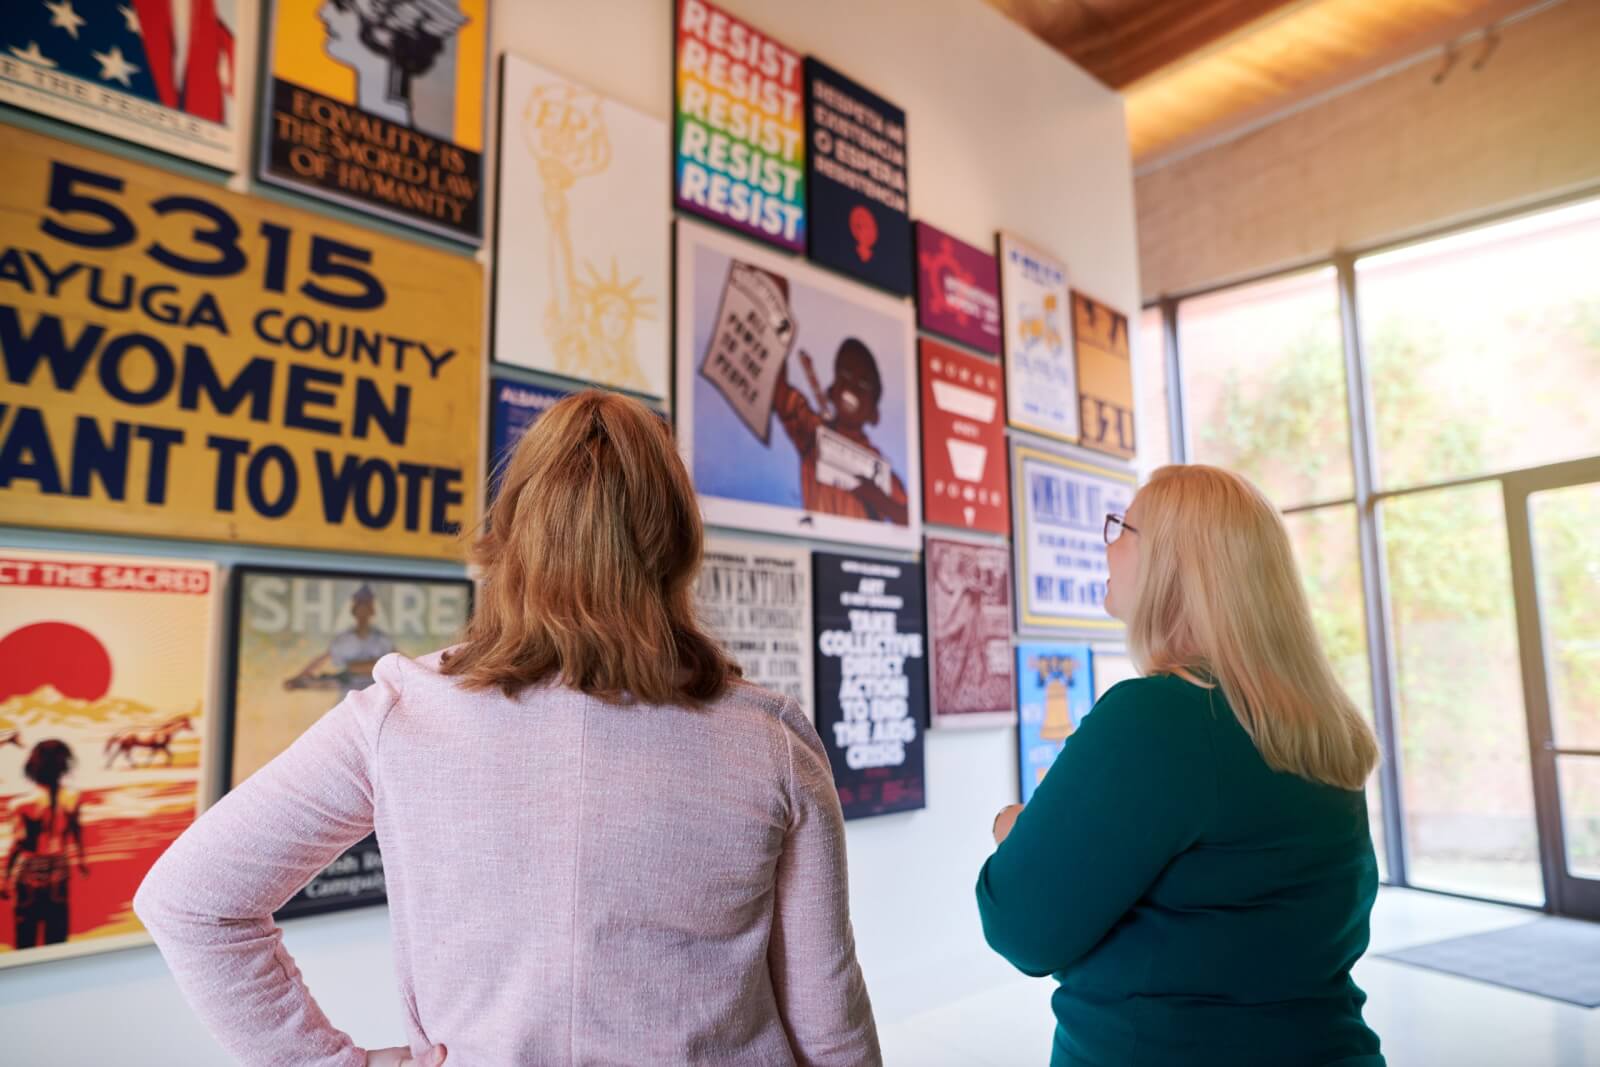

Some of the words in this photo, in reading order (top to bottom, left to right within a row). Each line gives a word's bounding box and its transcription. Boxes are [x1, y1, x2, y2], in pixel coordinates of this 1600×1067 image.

[33, 69, 88, 95] THE
[681, 0, 798, 84] RESIST
[682, 38, 800, 123] RESIST
[275, 110, 326, 148] THE
[681, 119, 801, 202] RESIST
[682, 79, 800, 162] RESIST
[813, 129, 833, 154] O
[289, 148, 328, 179] OF
[680, 161, 802, 243] RESIST
[40, 160, 387, 312] 5315
[0, 248, 230, 338] AYUGA
[253, 308, 457, 379] COUNTY
[0, 304, 412, 447] WOMEN
[0, 403, 185, 506] ANT
[207, 434, 299, 520] TO
[314, 448, 464, 536] VOTE
[40, 562, 96, 587] THE
[101, 567, 207, 594] SACRED
[249, 576, 465, 634] SHARE
[820, 630, 923, 658] COLLECTIVE
